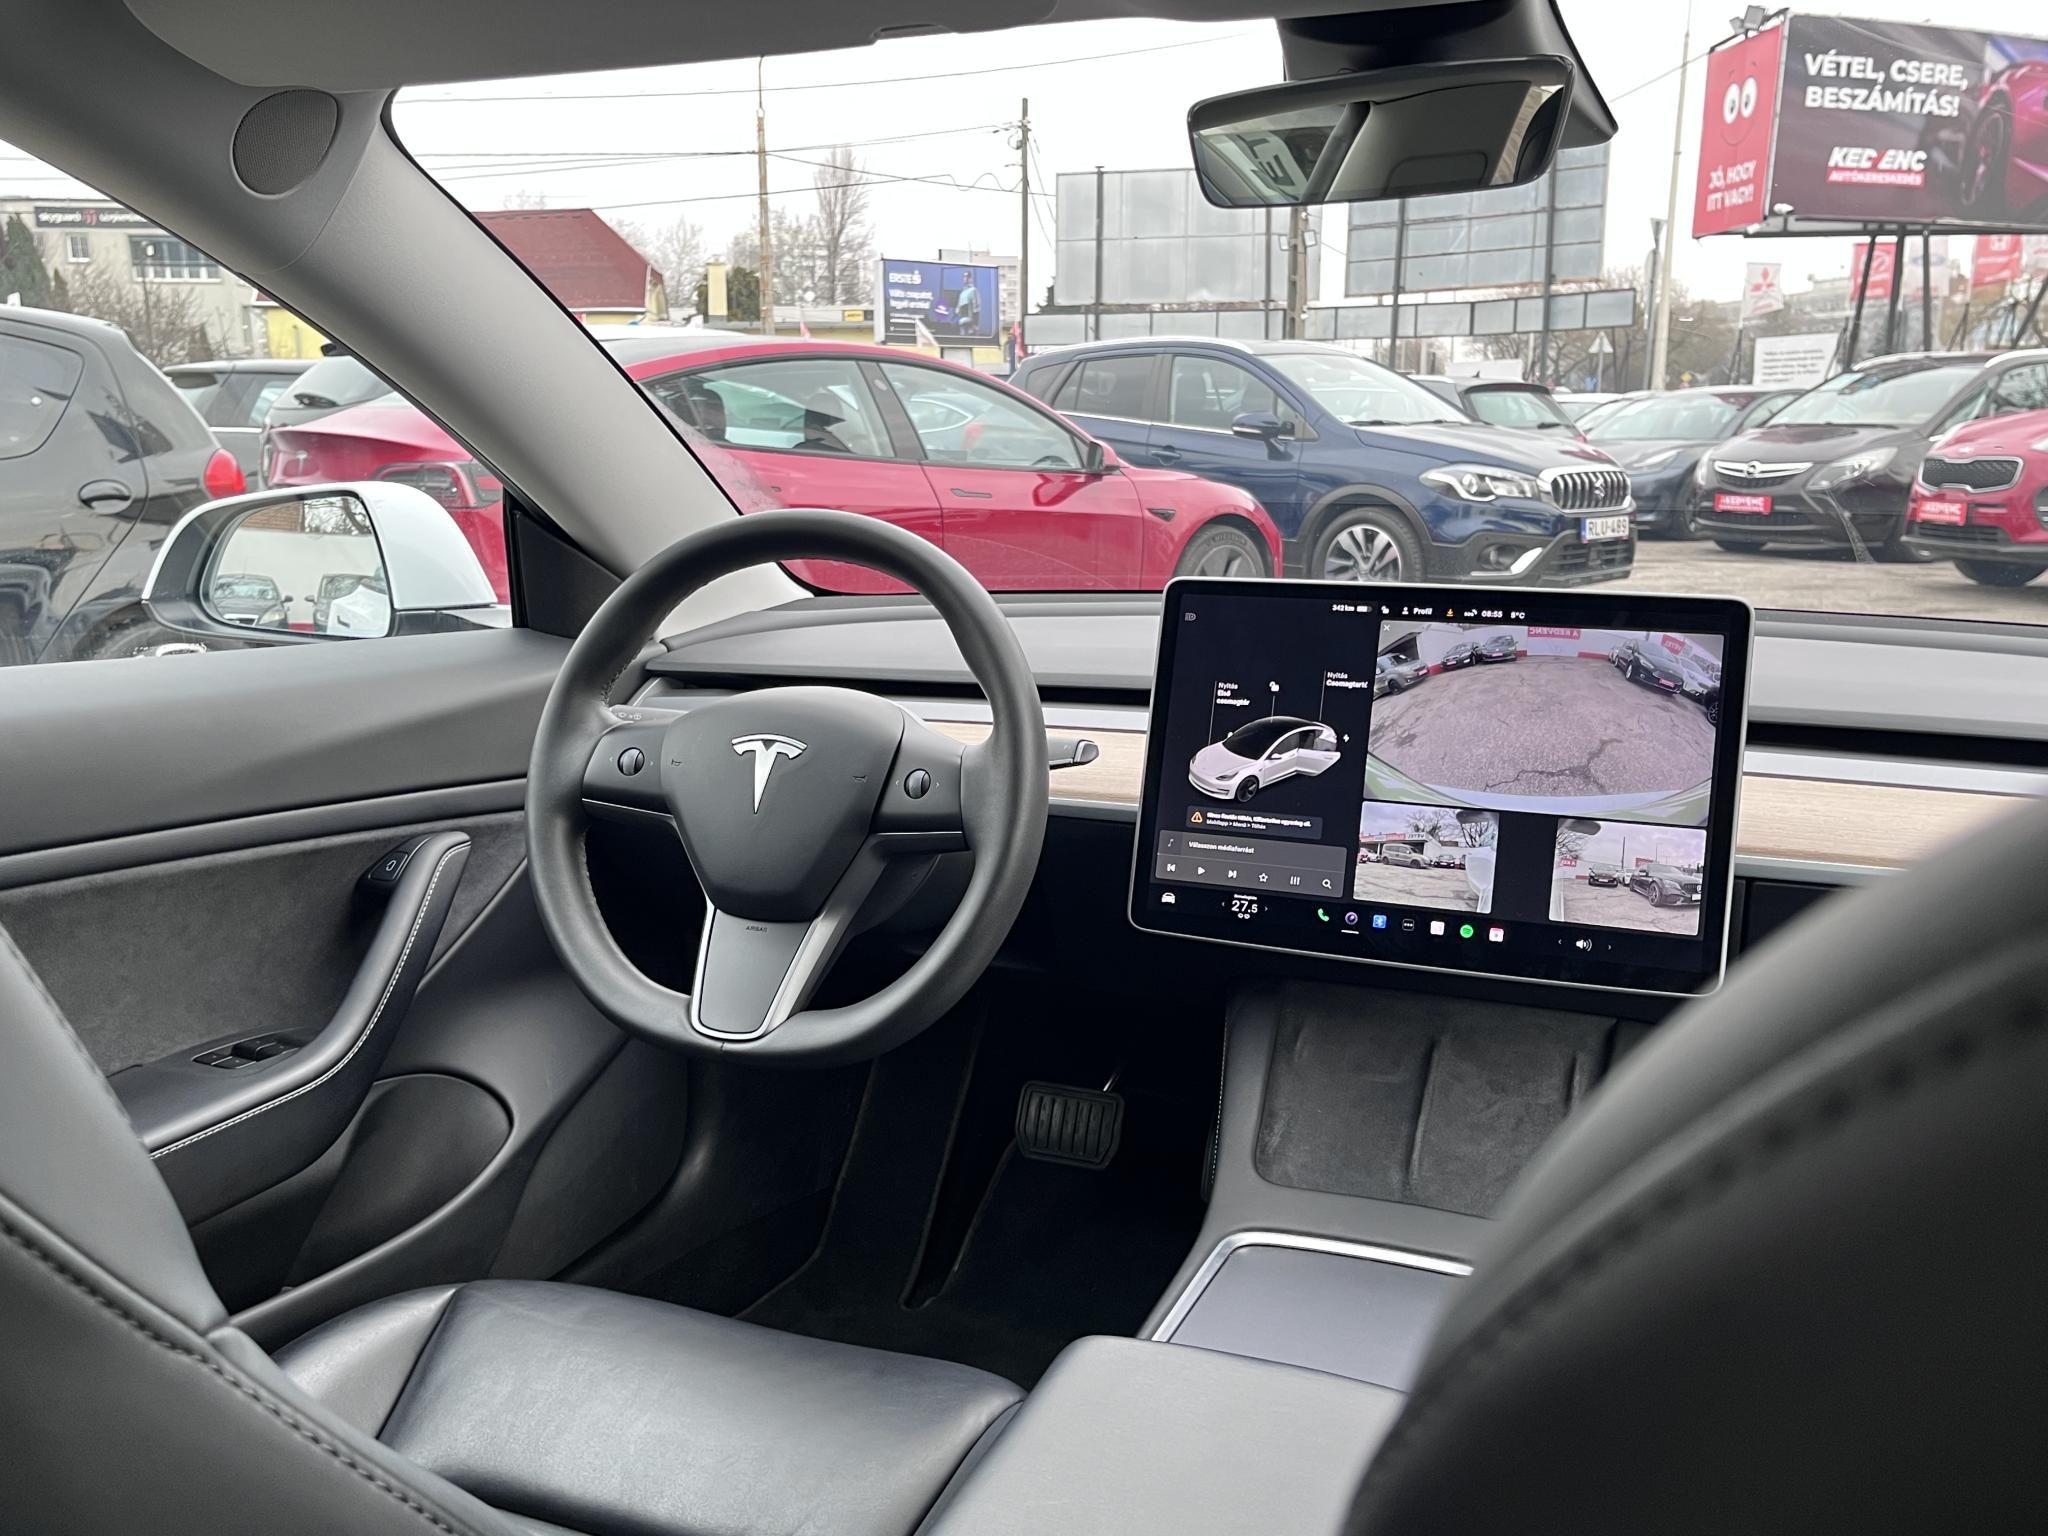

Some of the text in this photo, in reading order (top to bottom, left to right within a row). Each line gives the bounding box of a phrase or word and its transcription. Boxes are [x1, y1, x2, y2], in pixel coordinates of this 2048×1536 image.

[1805, 49, 1968, 91] VÉTEL, CSERE,
[1805, 85, 1960, 117] BESZÁMÍTÁS!
[1413, 607, 1433, 616] Profil
[1231, 900, 1258, 914] 27.5
